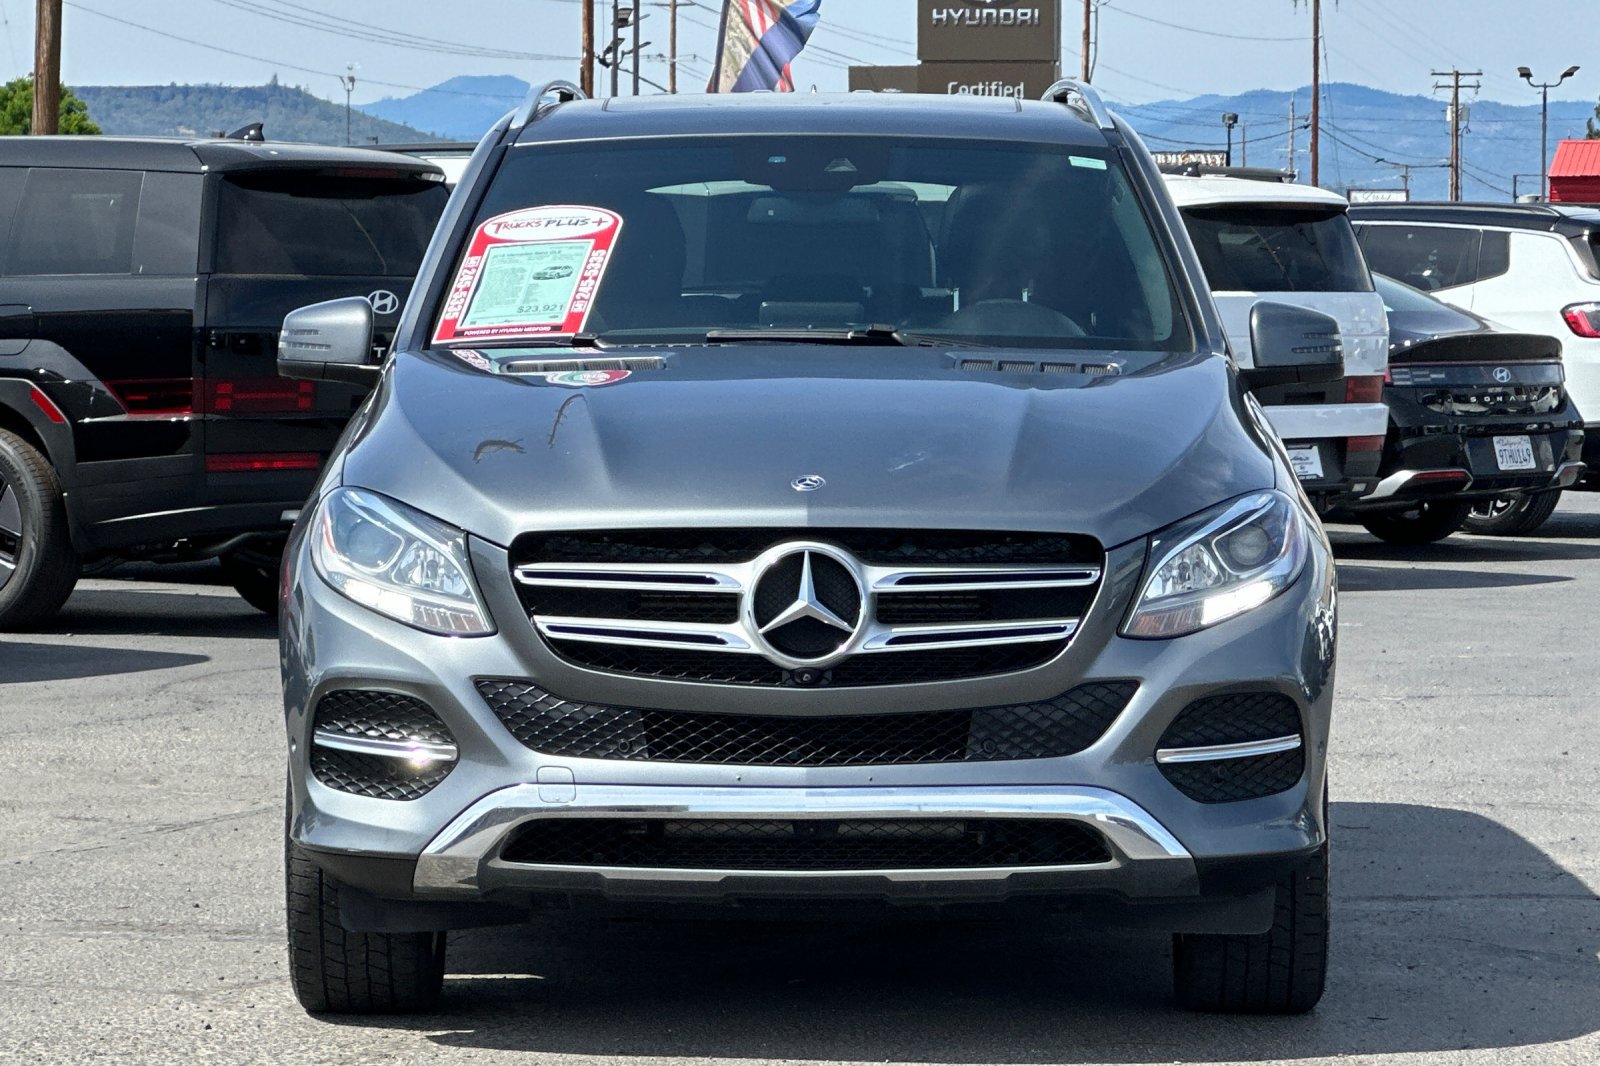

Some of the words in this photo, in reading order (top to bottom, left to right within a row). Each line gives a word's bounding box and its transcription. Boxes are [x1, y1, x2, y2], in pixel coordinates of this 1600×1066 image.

[932, 8, 1039, 25] HYUNDAI
[948, 82, 1024, 98] Certified
[1189, 153, 1222, 166] NAVY
[492, 220, 541, 233] TRUCKS
[544, 218, 591, 227] PLUS
[575, 249, 606, 300] 245-5335
